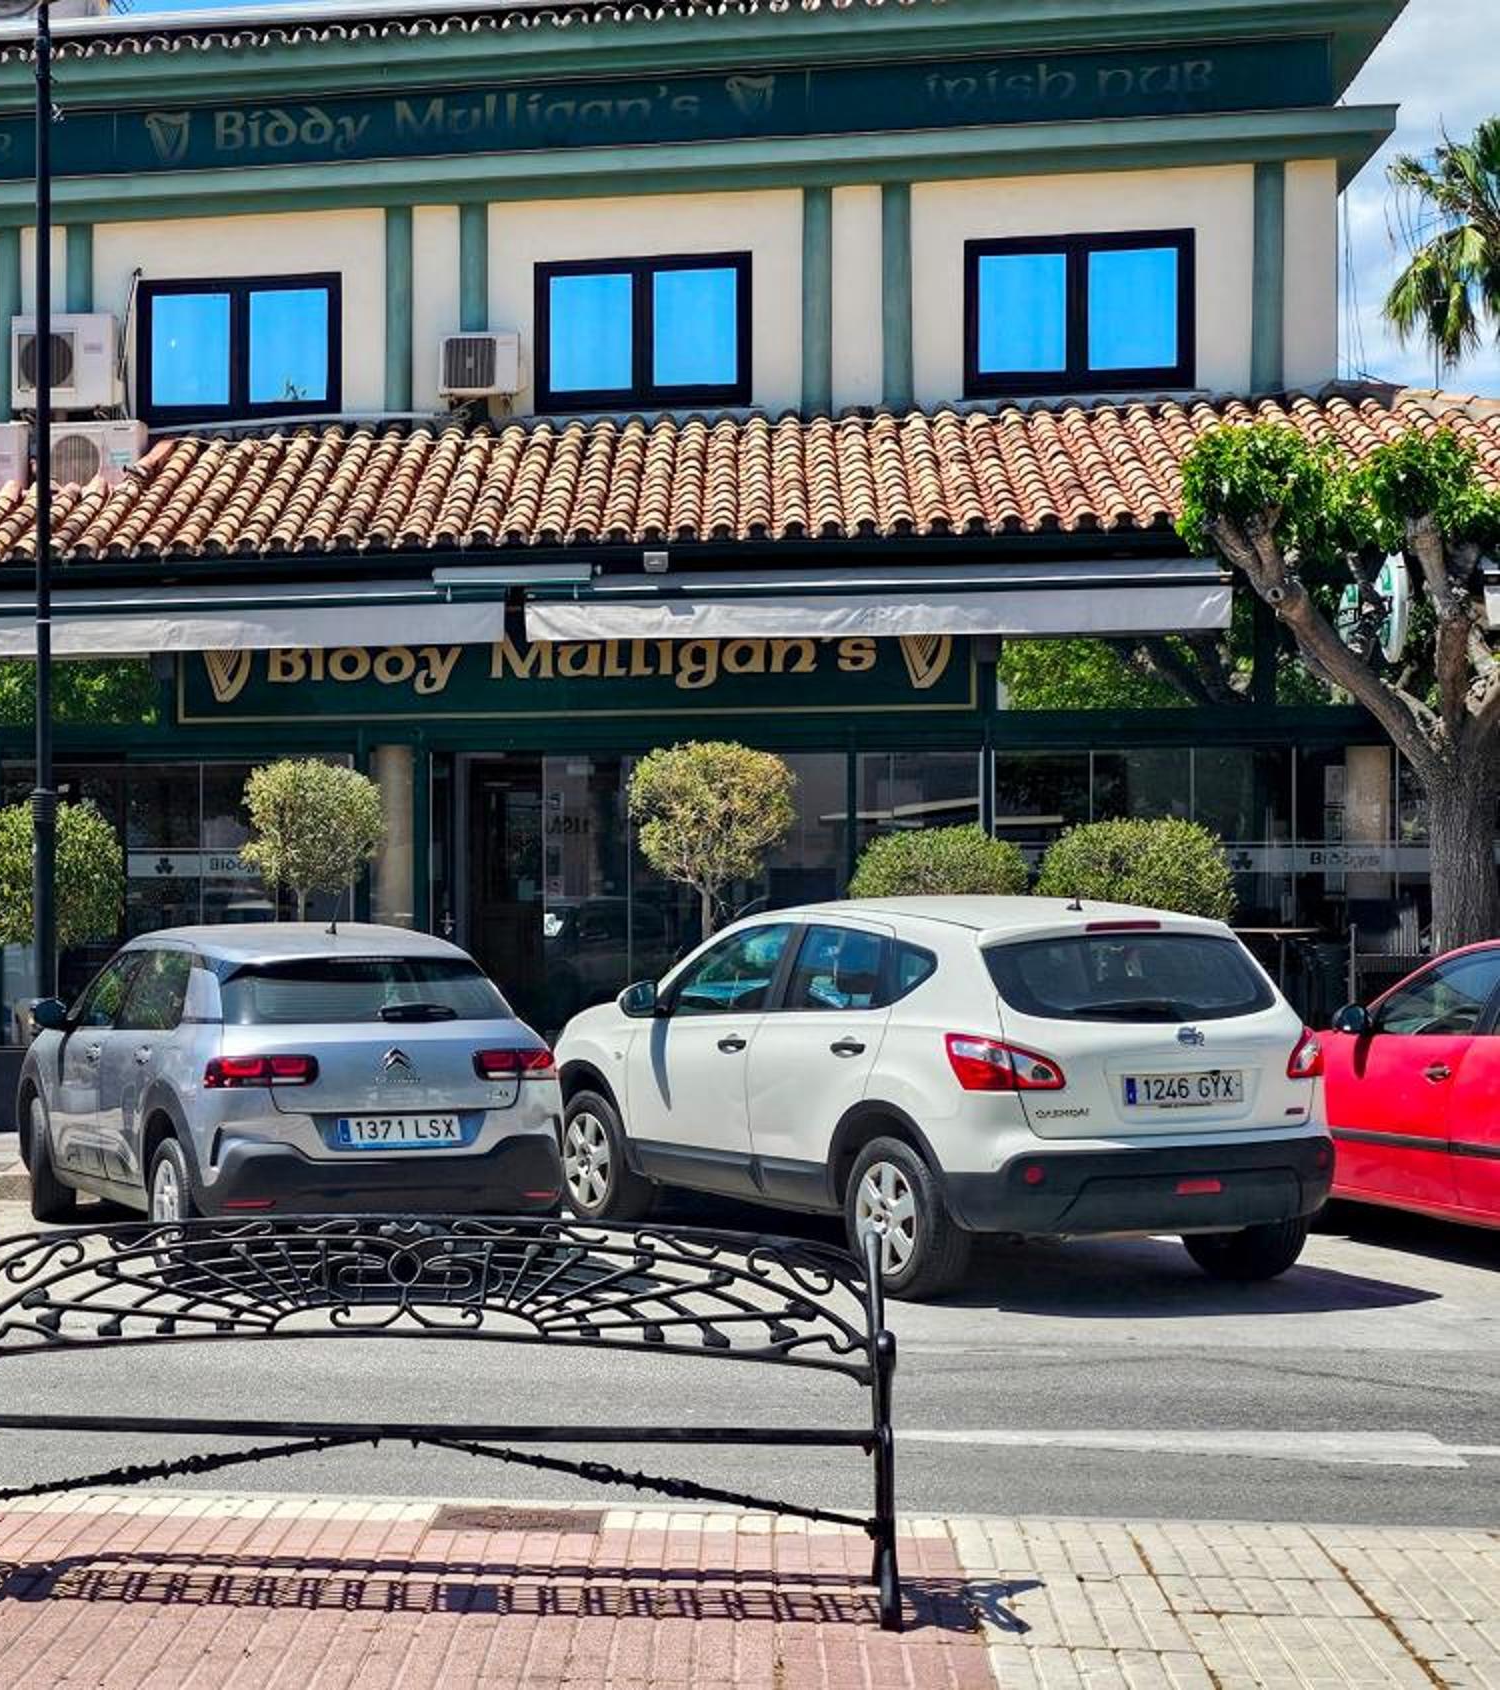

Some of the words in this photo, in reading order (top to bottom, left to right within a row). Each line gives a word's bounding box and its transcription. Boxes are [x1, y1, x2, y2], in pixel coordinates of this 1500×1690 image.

[213, 105, 372, 153] Biddy
[1142, 1080, 1190, 1101] 1246
[1198, 1074, 1235, 1099] GYX
[355, 1119, 405, 1140] 1371
[414, 1119, 455, 1139] LSX
